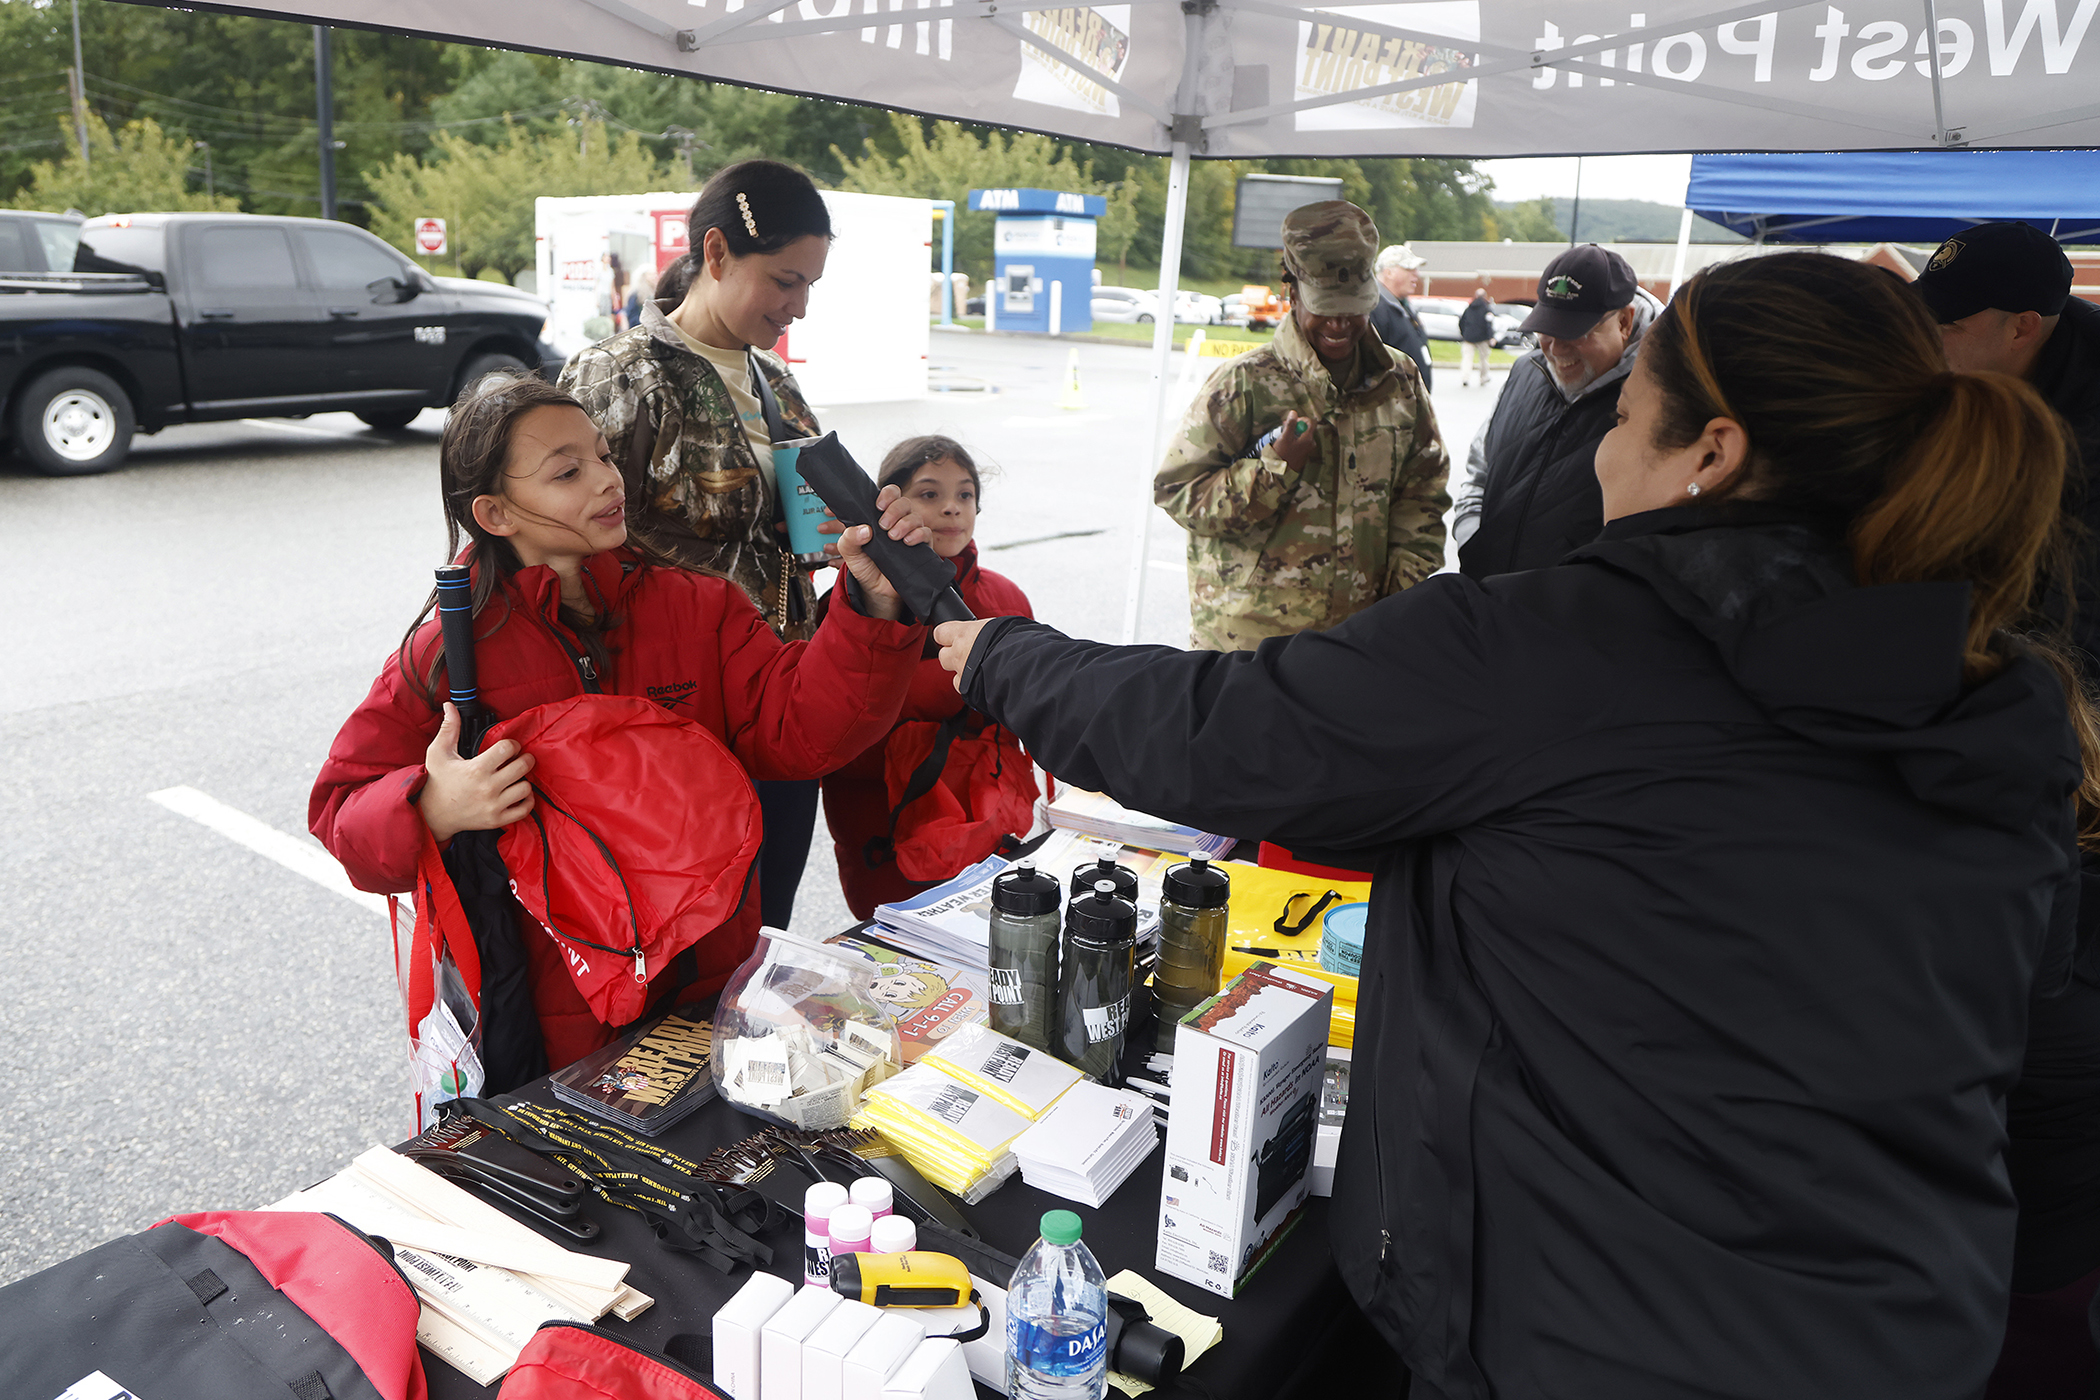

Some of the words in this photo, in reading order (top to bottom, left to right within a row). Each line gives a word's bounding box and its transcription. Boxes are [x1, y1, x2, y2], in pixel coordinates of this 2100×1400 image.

[979, 189, 1019, 210] ATM
[1055, 193, 1085, 213] ATM
[1213, 344, 1229, 357] NO
[646, 680, 697, 697] Reebok
[913, 893, 966, 918] WEATHER
[931, 992, 964, 1013] CALL
[992, 985, 1023, 1002] POINT
[901, 1014, 941, 1037] 9-1-1
[948, 1005, 976, 1026] WHEN
[936, 1019, 955, 1034] TO
[1086, 1018, 1122, 1041] WEST
[1243, 1022, 1266, 1038] Kaito
[615, 1014, 690, 1076] READY
[995, 1042, 1017, 1060] WEST
[981, 1056, 1006, 1078] POINT
[994, 1053, 1024, 1083] READY
[1262, 1058, 1279, 1082] Kaito
[622, 1062, 693, 1105] WEST
[943, 1084, 965, 1102] WEST
[1259, 1101, 1270, 1119] All
[1269, 1077, 1294, 1109] Hazards
[1301, 1052, 1320, 1079] NOAA
[929, 1099, 954, 1121] POINT
[942, 1096, 972, 1125] READY
[395, 1248, 418, 1266] POINT
[453, 1256, 479, 1274] POINT
